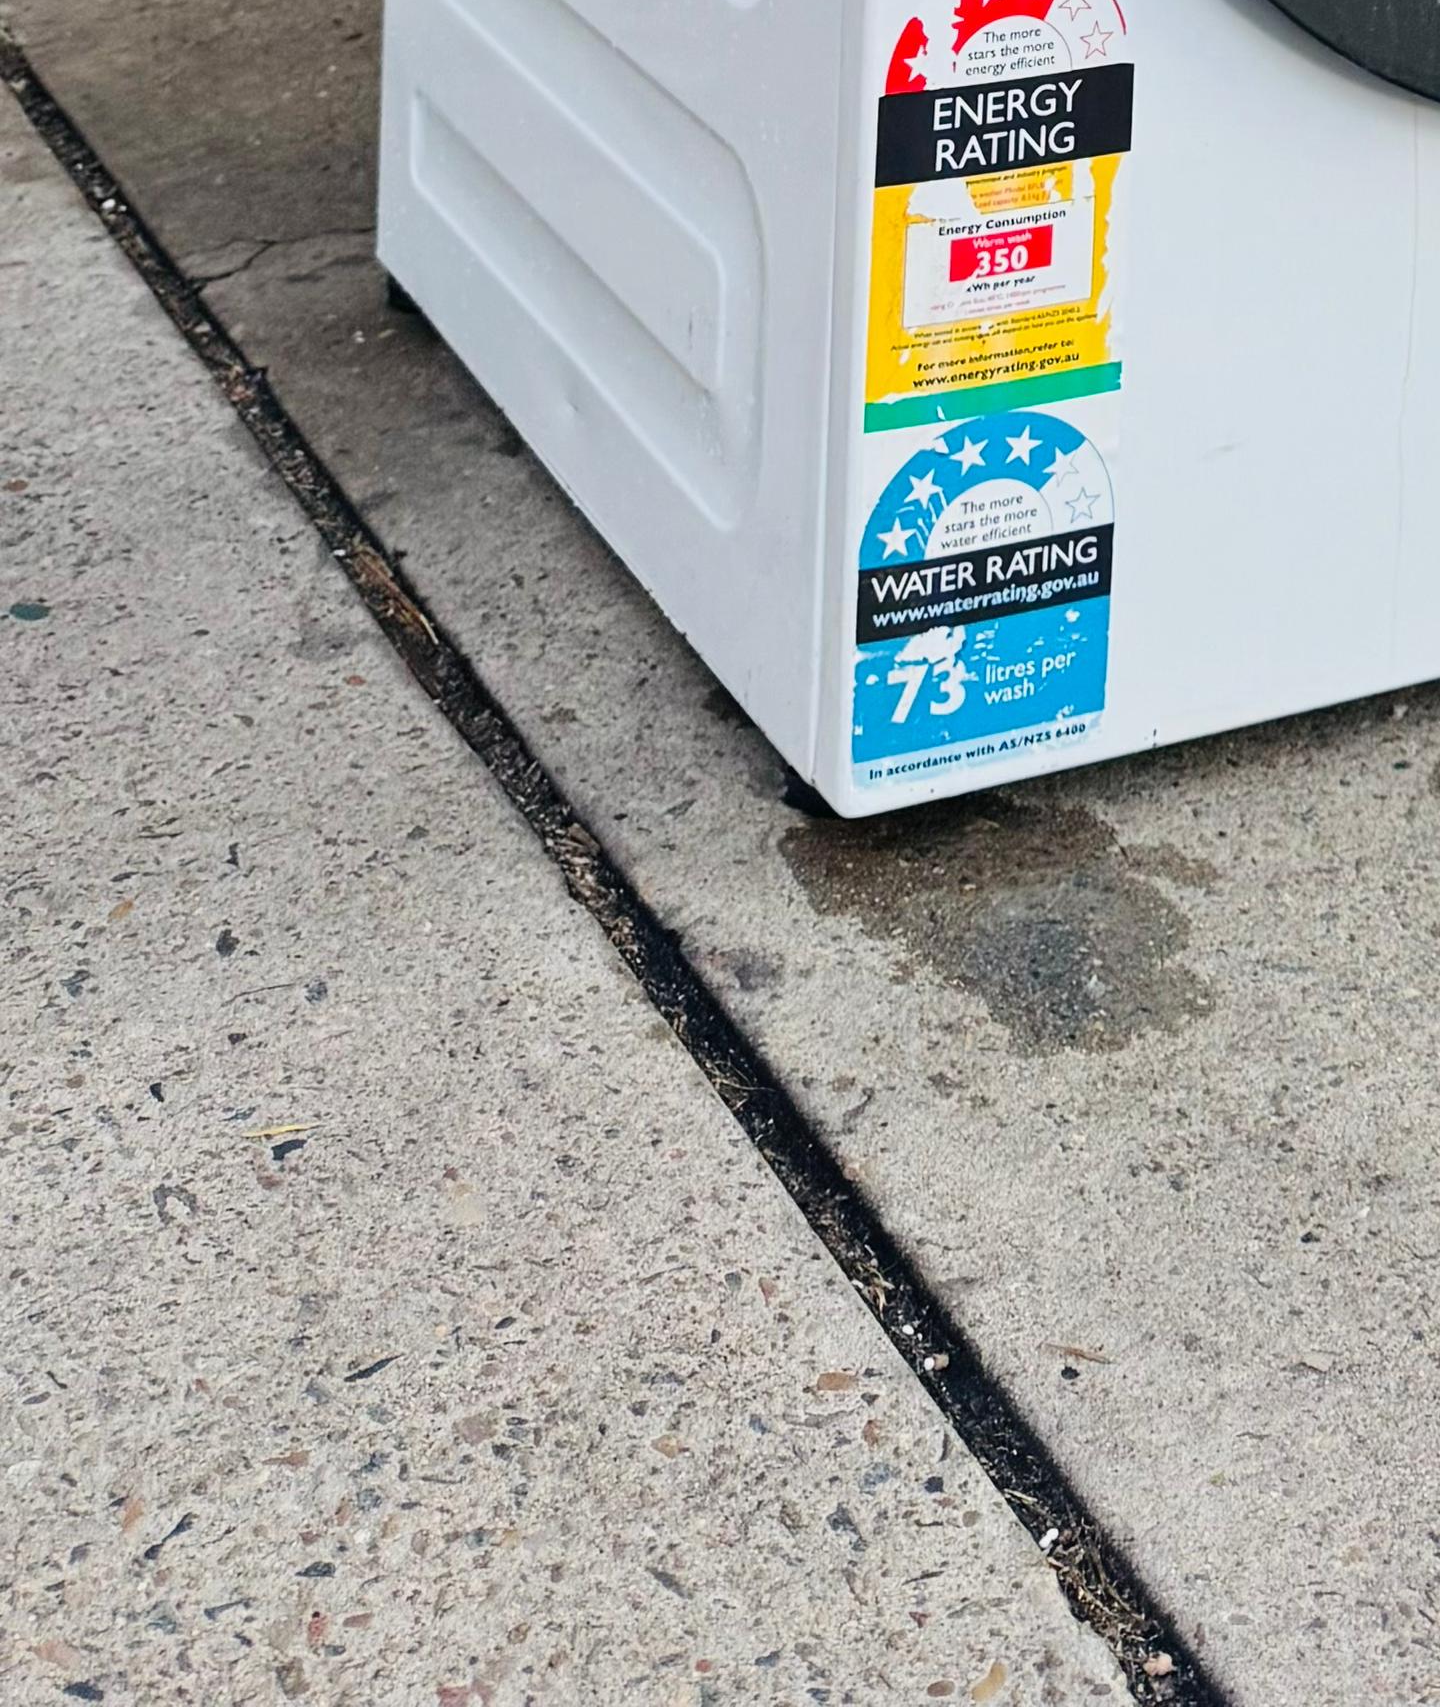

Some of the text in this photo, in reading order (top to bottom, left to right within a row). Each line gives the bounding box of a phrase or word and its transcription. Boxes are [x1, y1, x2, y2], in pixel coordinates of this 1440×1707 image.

[983, 28, 1042, 44] The more
[968, 41, 1054, 61] stars the more
[965, 54, 1055, 77] energy efficient
[932, 79, 1083, 131] ENERGY
[935, 121, 1076, 172] RATING
[938, 209, 1067, 236] Energy Consumption
[972, 232, 1033, 249] Warm wash
[975, 244, 1029, 277] 350
[993, 279, 1011, 292] per
[1013, 275, 1036, 288] year
[912, 352, 1081, 388] www.energyrating.gov.au
[938, 356, 967, 369] more
[960, 495, 1024, 514] The more
[944, 508, 1038, 534] stars the more
[941, 524, 1032, 550] water efficient
[871, 536, 1098, 603] WATER RATING
[872, 570, 1100, 628] www.waterrating.gov.au
[887, 651, 1077, 724] 73 litres per
[984, 678, 1035, 705] wash
[869, 722, 1086, 780] In accordance with AS/NZS 6400
